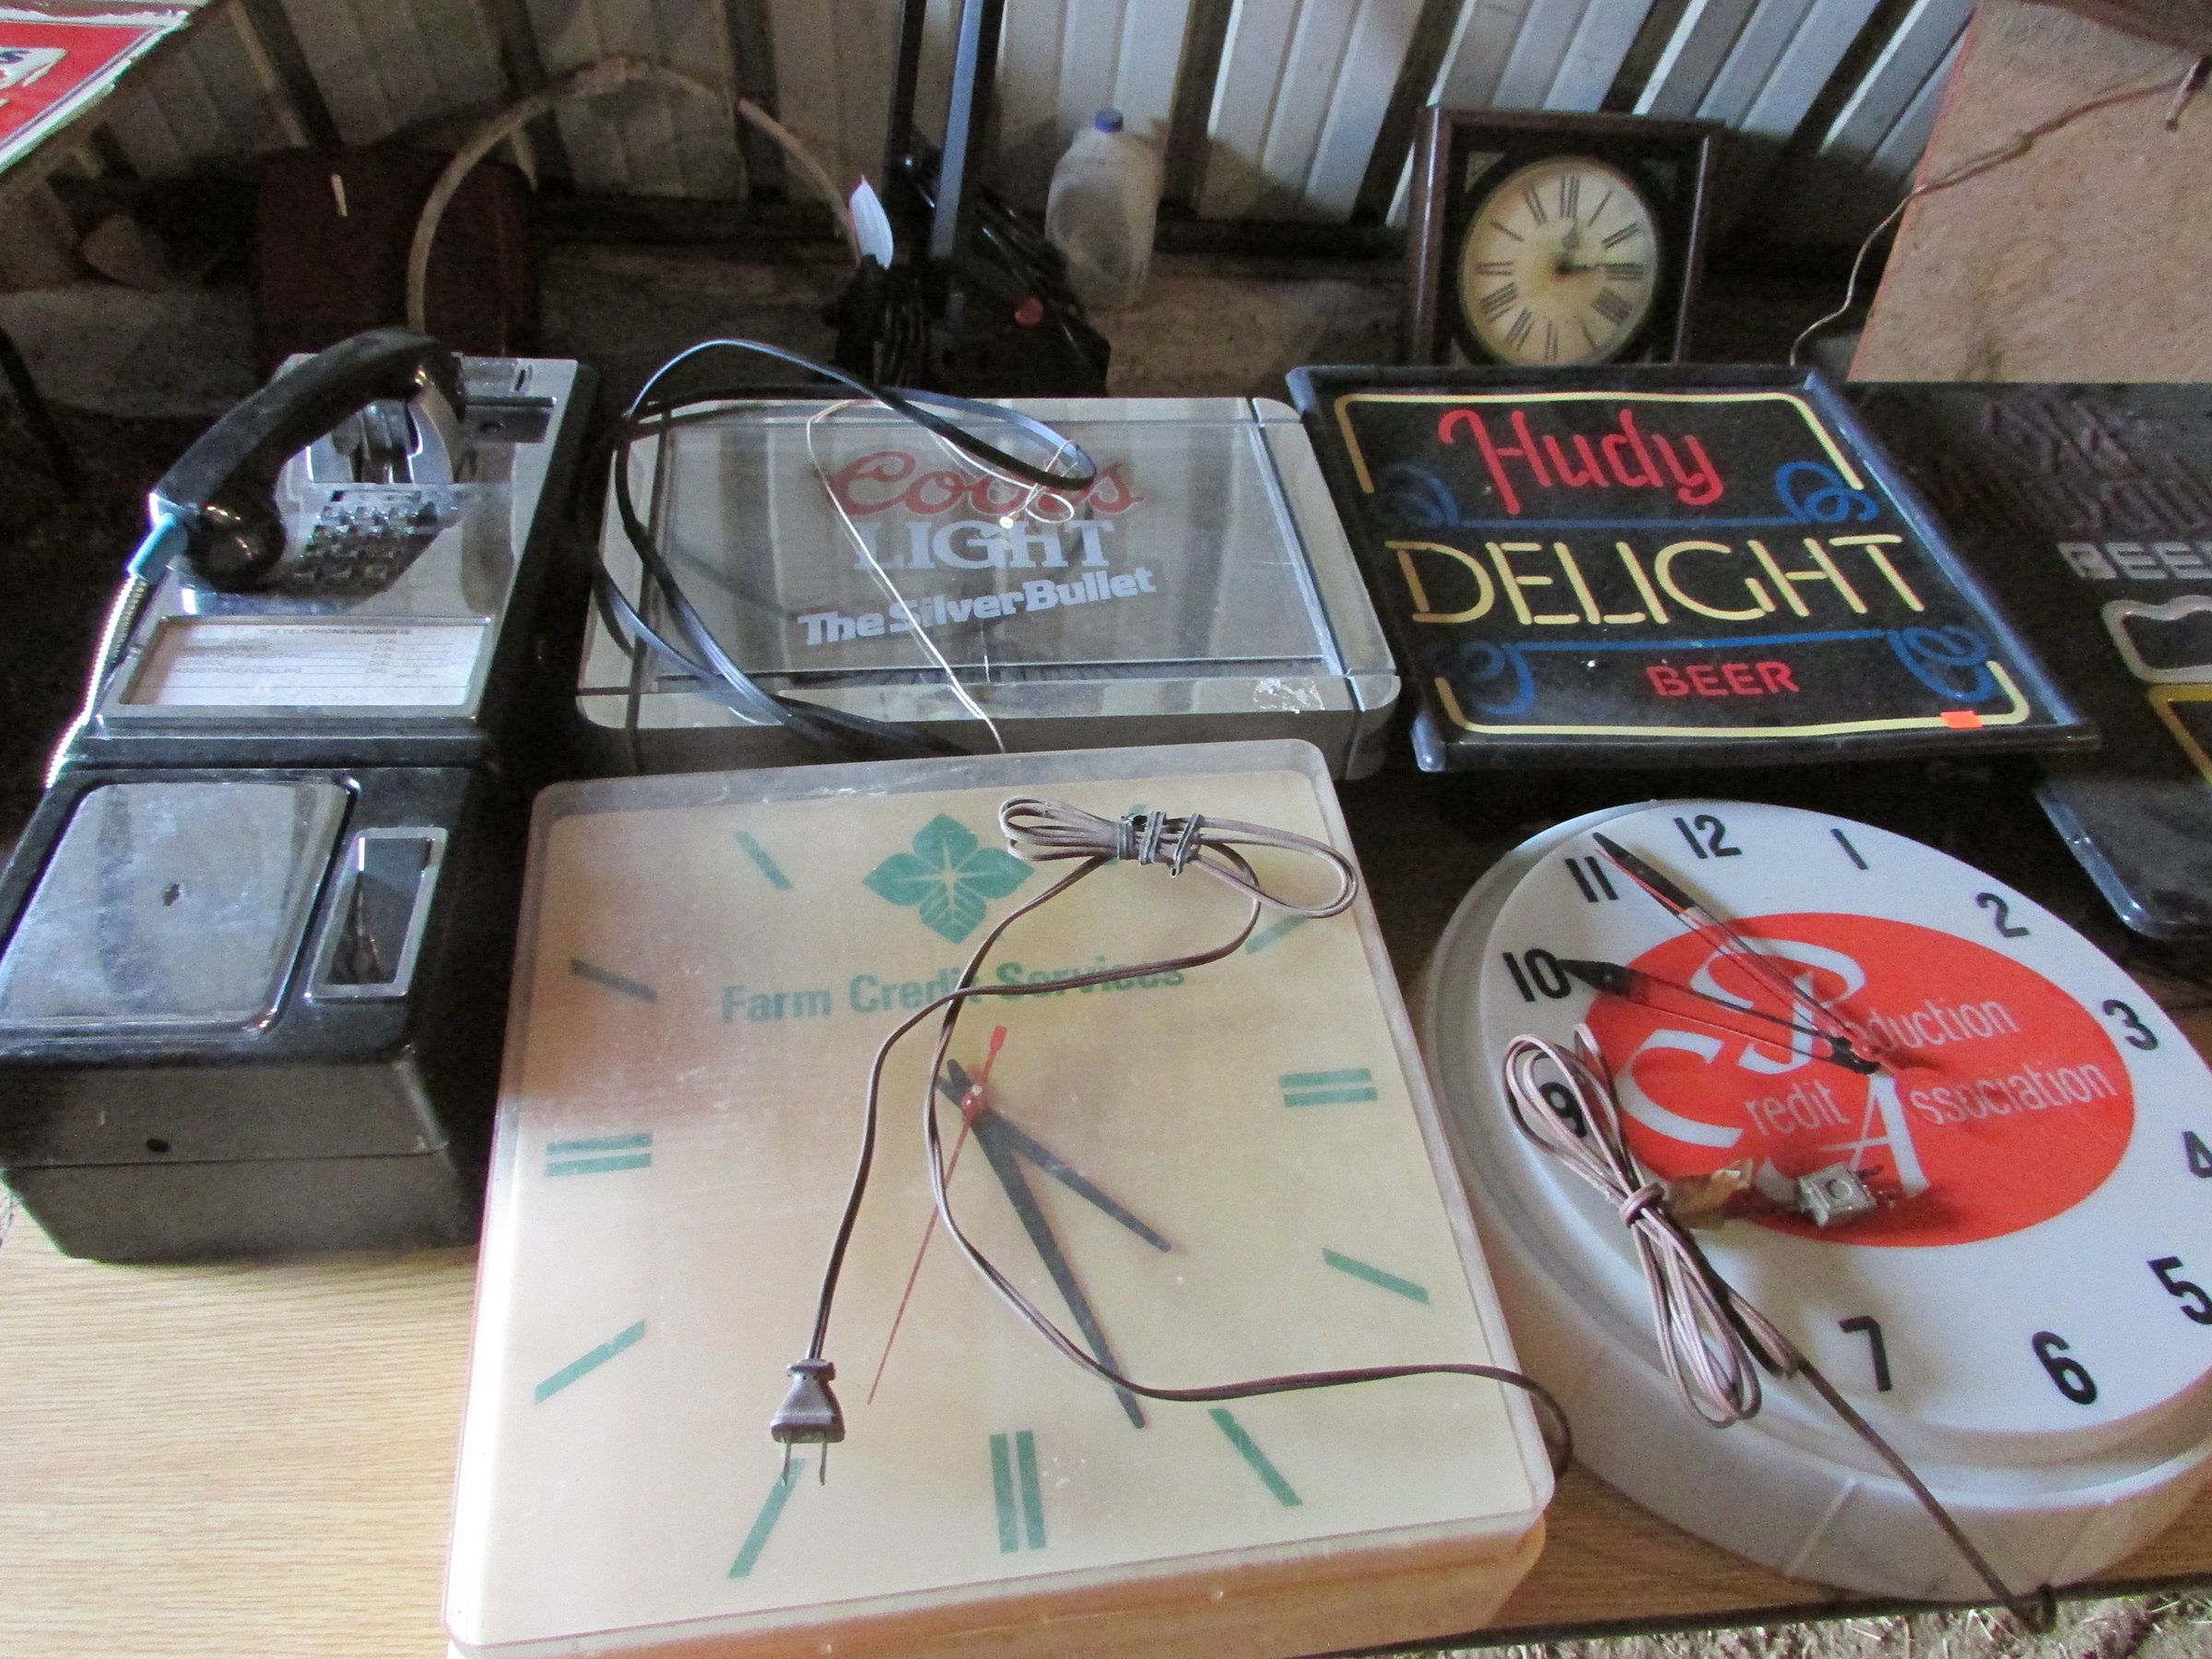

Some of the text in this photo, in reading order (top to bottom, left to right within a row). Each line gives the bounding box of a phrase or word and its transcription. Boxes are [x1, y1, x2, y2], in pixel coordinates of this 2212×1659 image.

[1439, 407, 1724, 514] Hudy
[797, 566, 1158, 645] The Silver Bullet
[1383, 533, 1924, 626] DELIGHT
[1645, 660, 1801, 698] BEER
[1674, 814, 1743, 859] 12
[1830, 829, 1868, 870] 1
[1564, 856, 1619, 903] 11
[1976, 892, 2030, 938] 2
[719, 981, 831, 1024] Farm
[995, 955, 1185, 1002] Services
[1501, 947, 1571, 1003] 10
[2102, 999, 2159, 1052] 3
[1539, 1081, 1587, 1138] 9
[2147, 1255, 2212, 1324] 5
[1839, 1314, 1892, 1392] 7
[2031, 1331, 2098, 1406] 6
